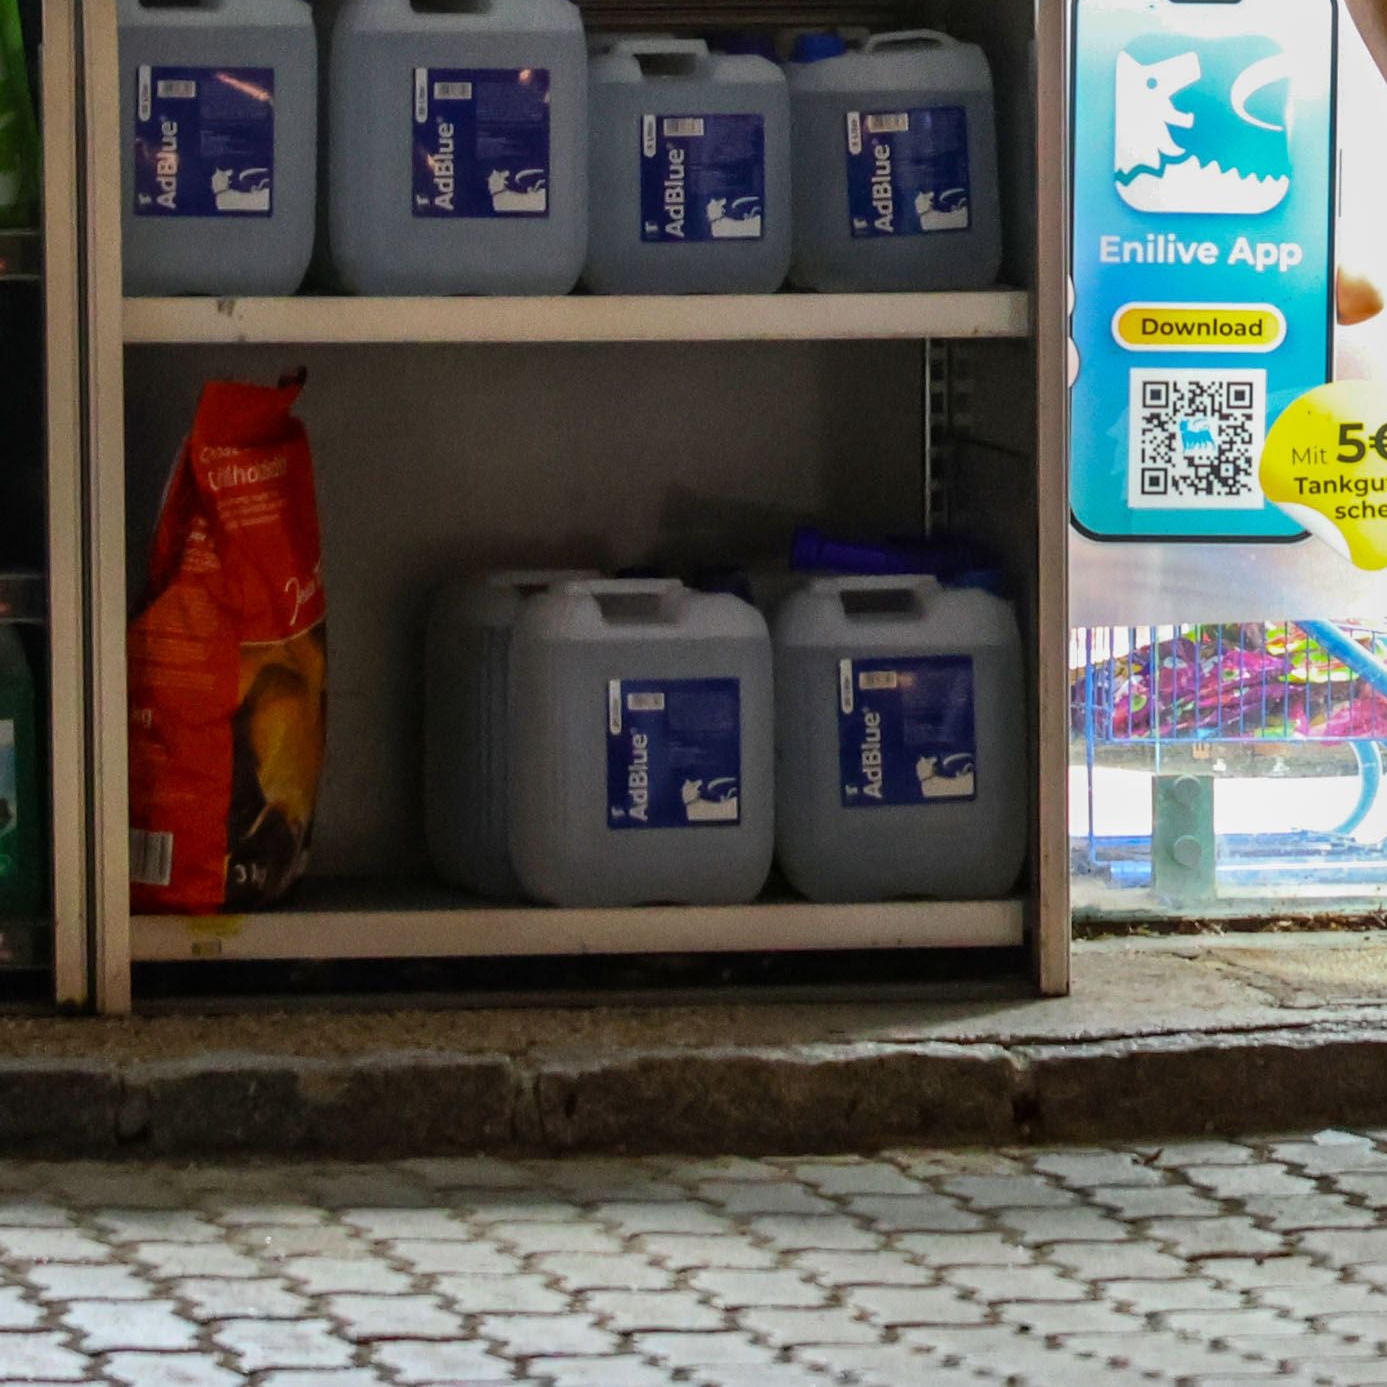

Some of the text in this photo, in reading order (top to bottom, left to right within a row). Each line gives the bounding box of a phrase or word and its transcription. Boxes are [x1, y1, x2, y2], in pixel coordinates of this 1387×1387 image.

[1100, 233, 1303, 272] Enilive App
[1141, 317, 1264, 338] Download
[1292, 447, 1327, 466] Mit
